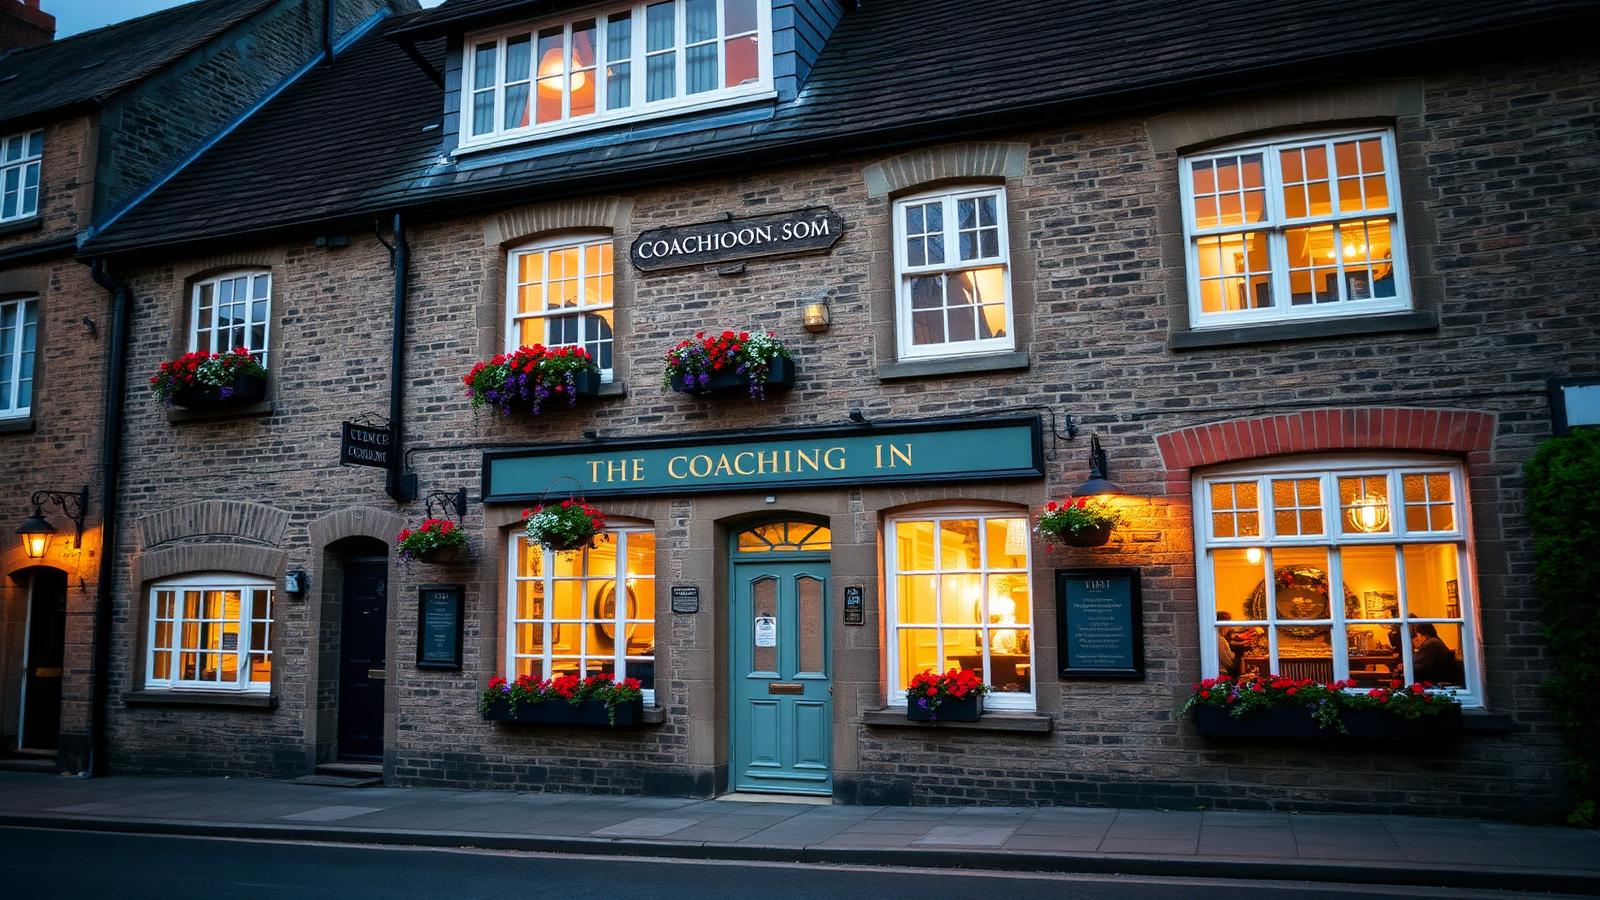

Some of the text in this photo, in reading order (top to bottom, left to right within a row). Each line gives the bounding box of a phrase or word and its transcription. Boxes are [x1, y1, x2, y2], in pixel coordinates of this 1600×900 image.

[586, 443, 913, 483] THE COACHING IN
